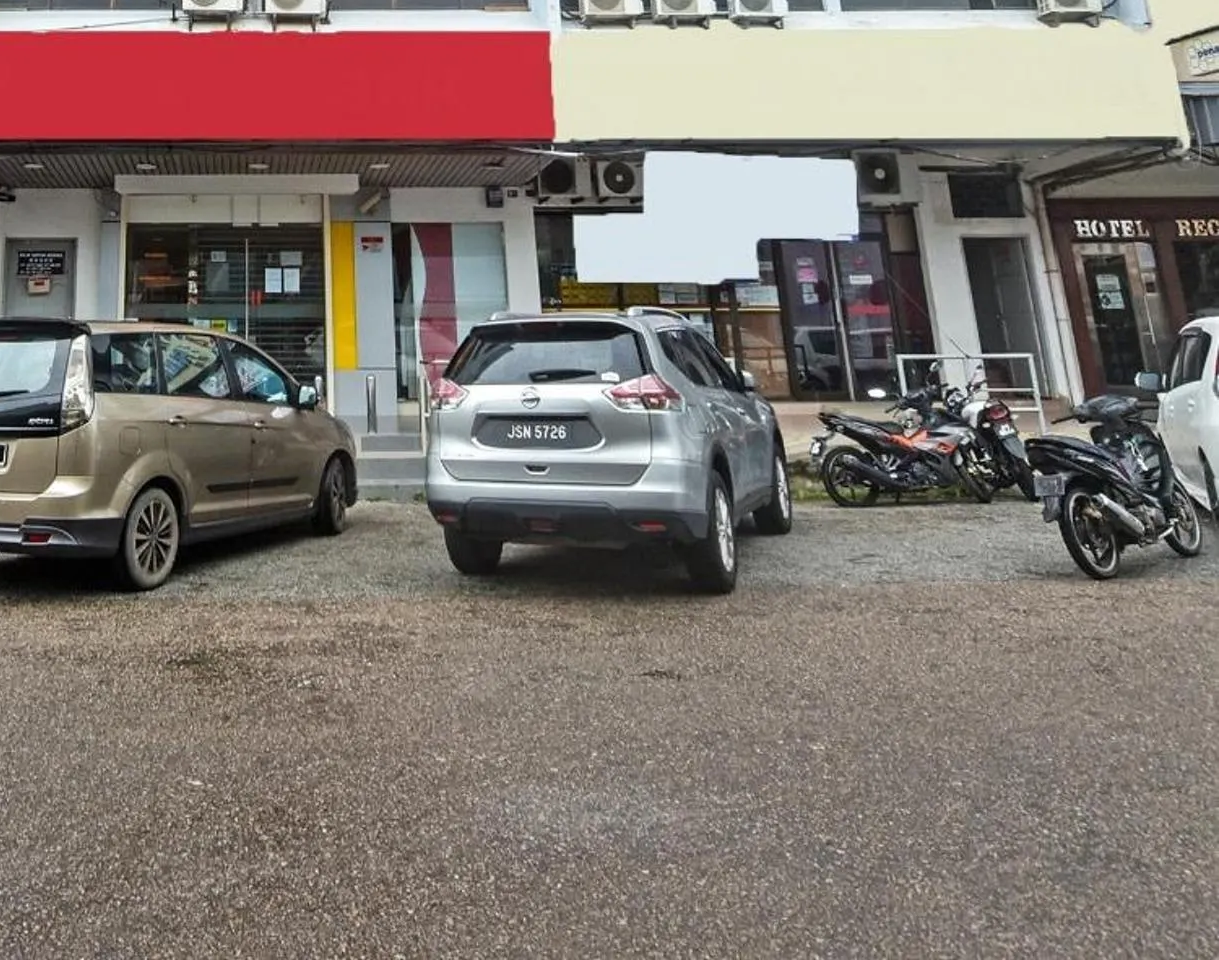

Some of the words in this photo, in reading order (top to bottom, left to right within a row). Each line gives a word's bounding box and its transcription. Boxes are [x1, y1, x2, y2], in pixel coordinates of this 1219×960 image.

[1073, 219, 1151, 238] HOTEL
[507, 425, 531, 440] JSN
[534, 425, 567, 440] 5726
